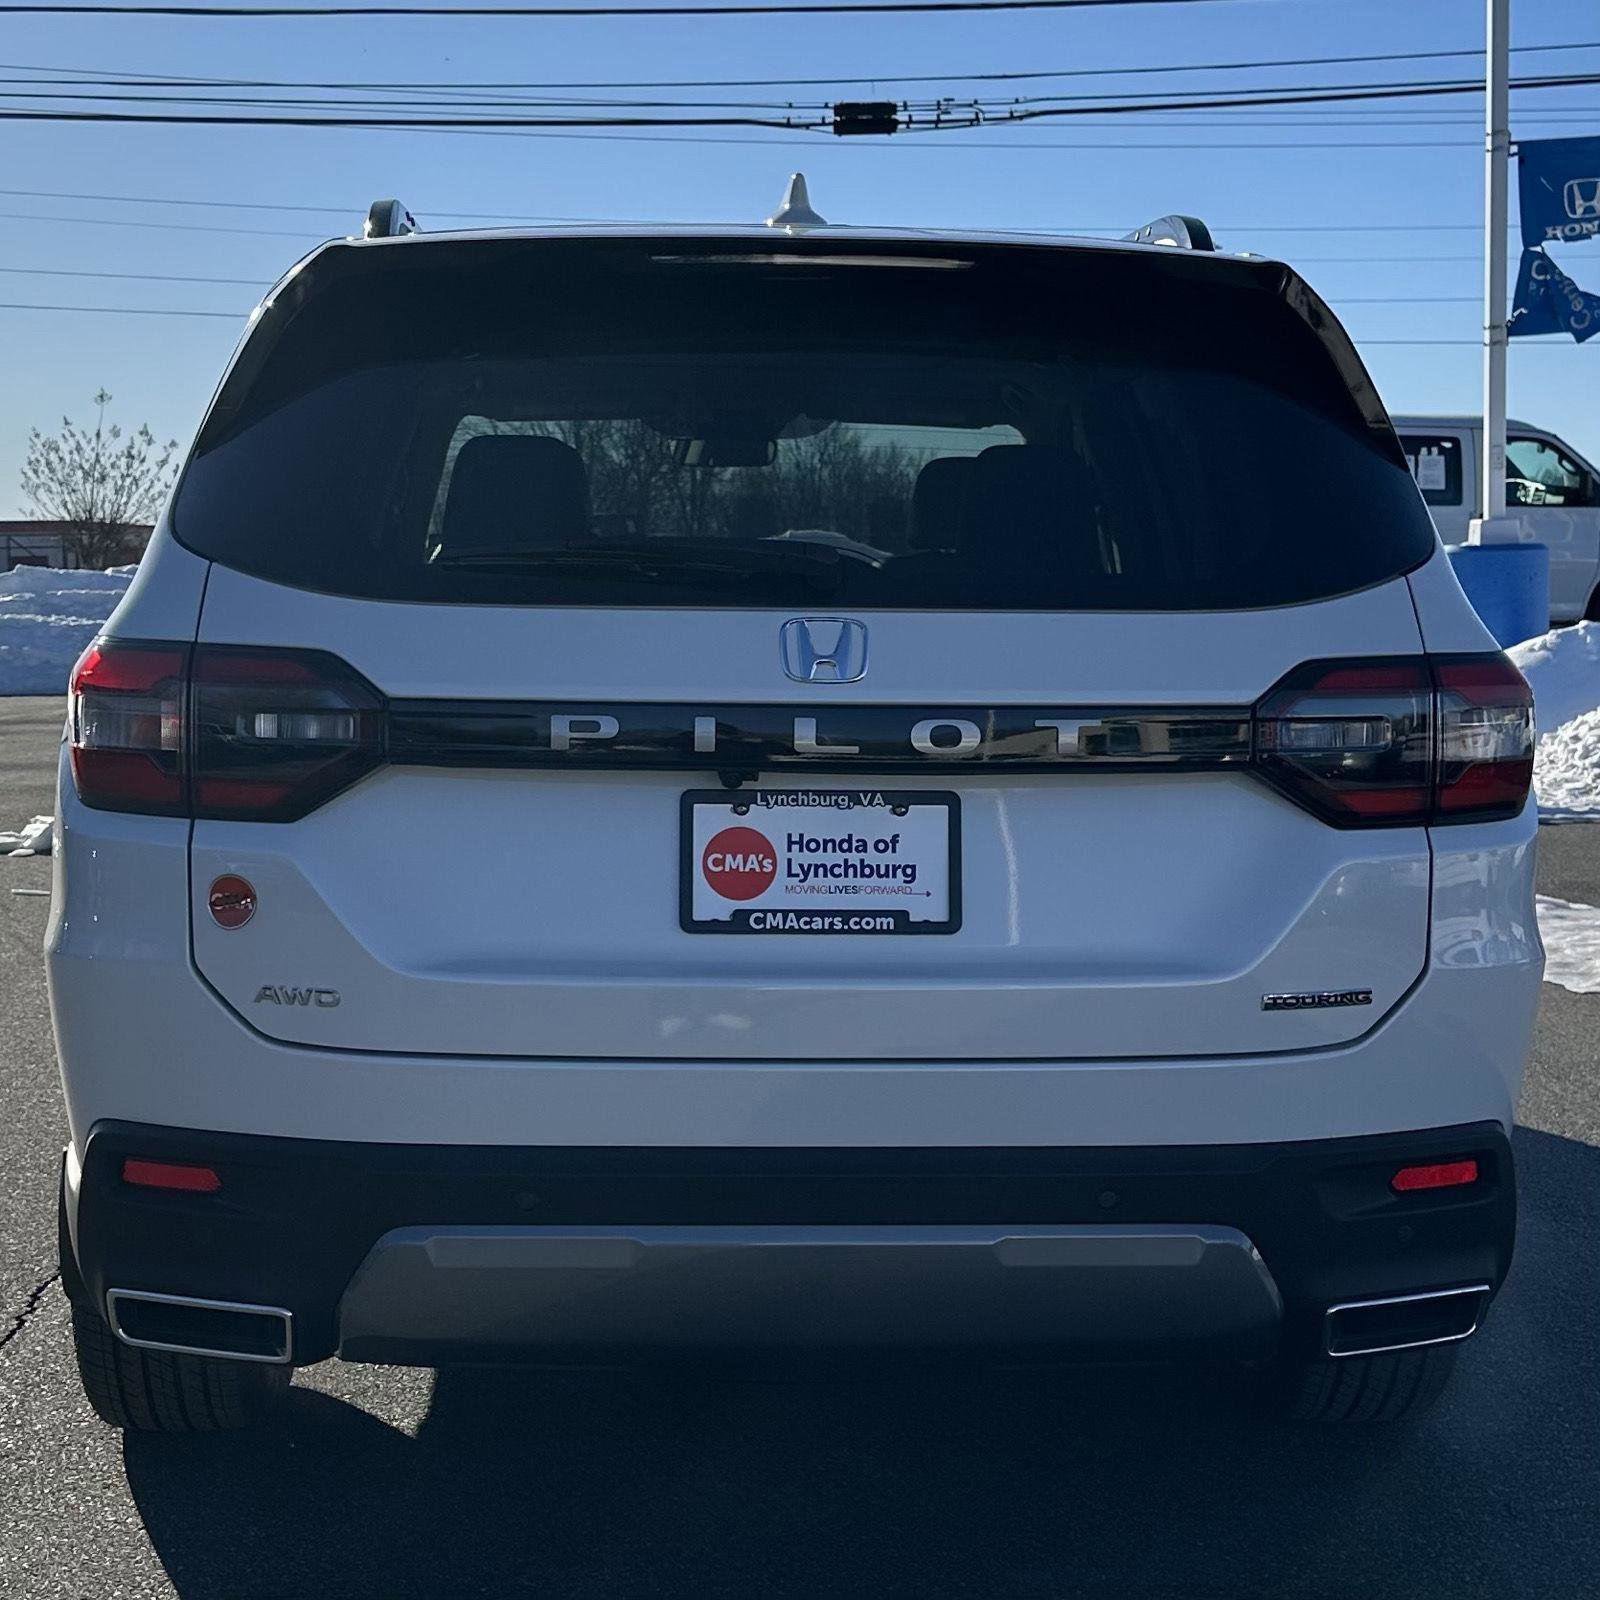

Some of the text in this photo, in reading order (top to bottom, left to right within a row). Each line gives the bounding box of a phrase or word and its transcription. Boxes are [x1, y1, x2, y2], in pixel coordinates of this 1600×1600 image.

[550, 713, 1102, 755] PILOT
[756, 791, 886, 809] Lynchburg, VA
[786, 833, 901, 854] Honda of
[706, 852, 774, 873] CMA's
[786, 858, 917, 884] Lynchburg
[749, 911, 895, 931] CMAcars.com
[254, 984, 342, 1008] AWD
[1262, 989, 1373, 1010] TOURING
